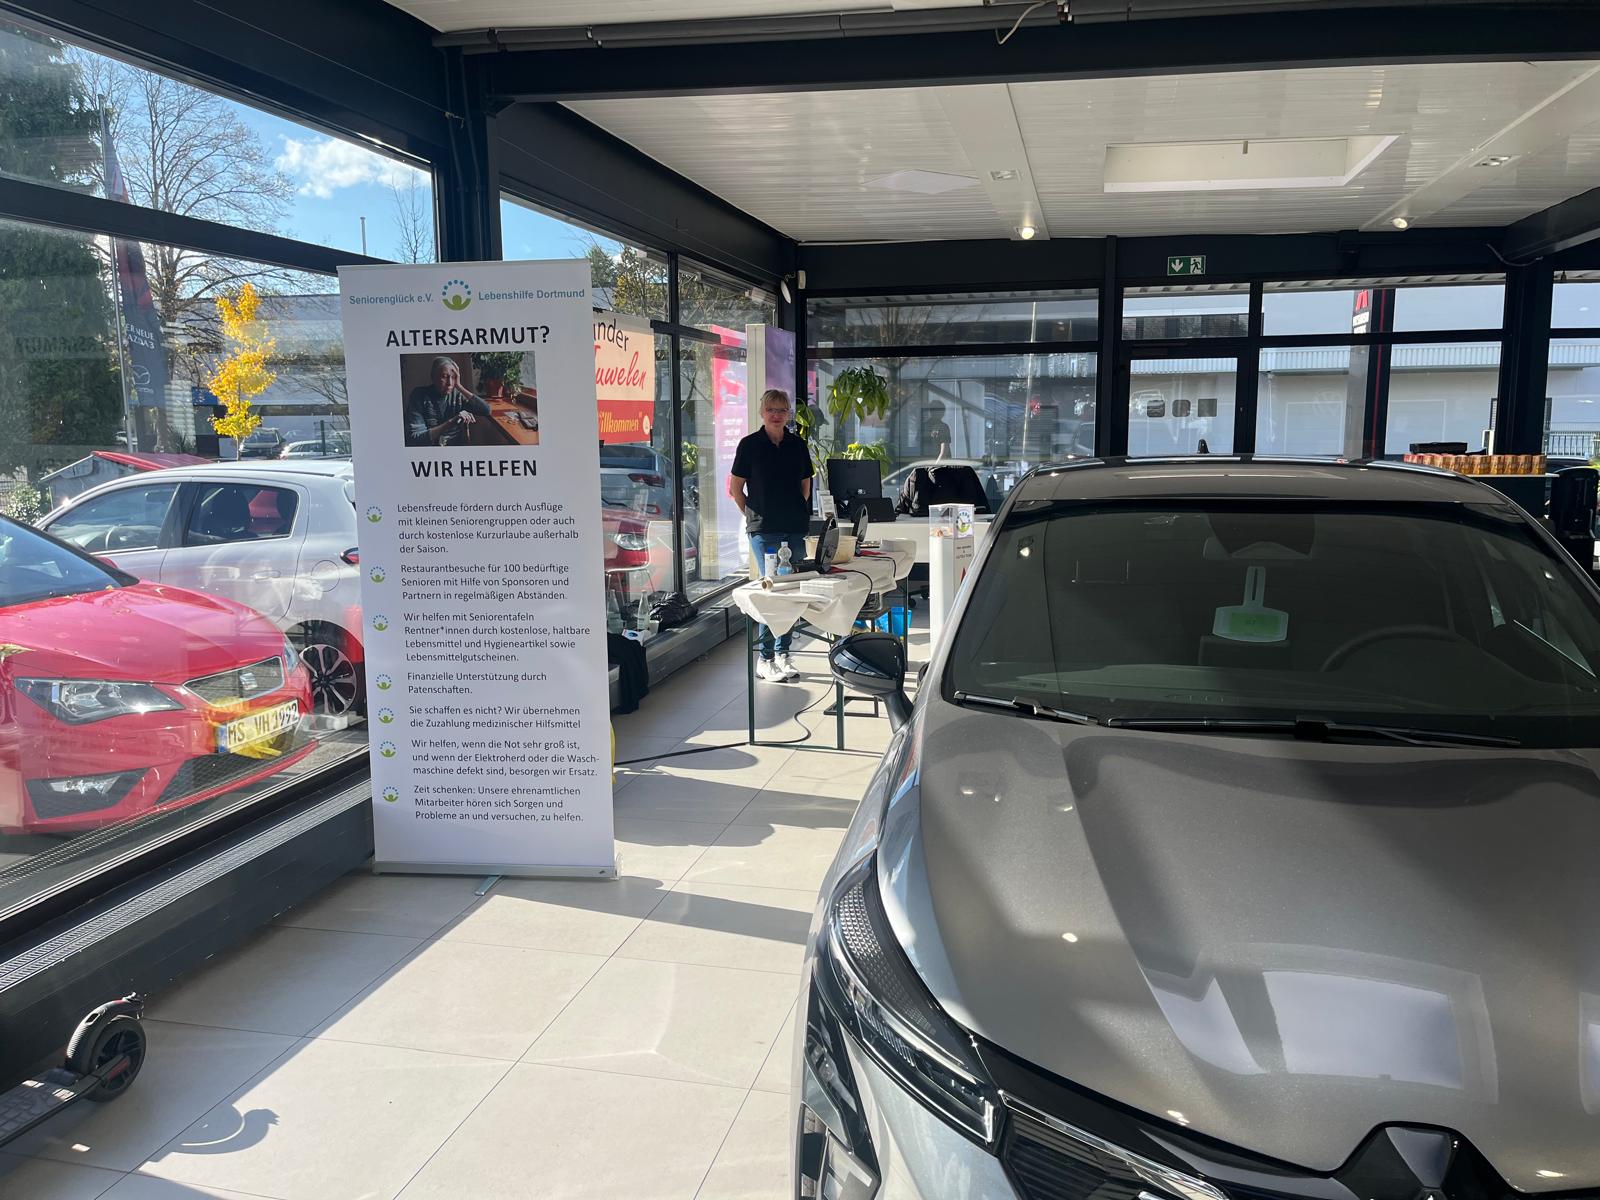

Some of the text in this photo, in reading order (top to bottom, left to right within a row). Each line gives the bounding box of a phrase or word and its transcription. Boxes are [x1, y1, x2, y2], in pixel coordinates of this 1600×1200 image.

[349, 289, 585, 305] Seniorenglück e.V. Lebenshilfe Dortmund
[128, 334, 155, 350] AZDA3
[386, 326, 550, 347] ALTERSARMUT?
[411, 460, 538, 478] WIR HELFEN
[397, 502, 563, 514] Lebensfreude fördern durch Ausflüge
[398, 516, 575, 528] mit kleinen Seniorengruppen oder auch
[399, 530, 579, 540] durch kostenlose Kurzurlaube außerhalb
[399, 544, 448, 553] der Saison.
[401, 564, 569, 575] Restaurantbesuche für 100 bedürftige
[401, 577, 441, 587] Senioren
[443, 577, 458, 586] mit
[460, 577, 481, 586] Hilfe
[501, 577, 550, 588] Sponsoren
[552, 577, 569, 586] und
[402, 590, 568, 602] Partnern in regelmäßigen Abständen.
[403, 612, 534, 622] Wir helfen mit Seniorentafeln
[472, 626, 498, 635] durch
[500, 626, 551, 636] kostenlose,
[552, 626, 590, 635] haltbare
[405, 639, 576, 650] Lebensmittel und Hygieneartikel sowie
[406, 652, 519, 664] Lebensmittelgutscheinen.
[407, 672, 547, 683] Finanzielle Unterstützung durch
[408, 685, 473, 694] Patenschaften.
[409, 705, 580, 715] Sie schaffen es nicht? Wir übernehmen
[228, 702, 298, 746] MS VH 1992
[410, 719, 581, 730] die Zuzahlung medizinischer Hilfsmittel
[411, 739, 580, 751] Wir helfen, wenn die Not sehr groß ist,
[412, 753, 429, 762] und
[457, 753, 472, 762] der
[474, 753, 526, 762] Elektroherd
[528, 753, 549, 763] oder
[551, 754, 565, 763] die
[567, 754, 600, 763] Wasch-
[413, 766, 598, 778] maschine defekt sind, besorgen wir Ersatz.
[414, 785, 581, 795] Zeit schenken: Unsere ehrenamtlichen
[415, 798, 563, 810] Mitarbeiter hören sich Sorgen und
[415, 811, 584, 822] Probleme an und versuchen, zu helfen.
